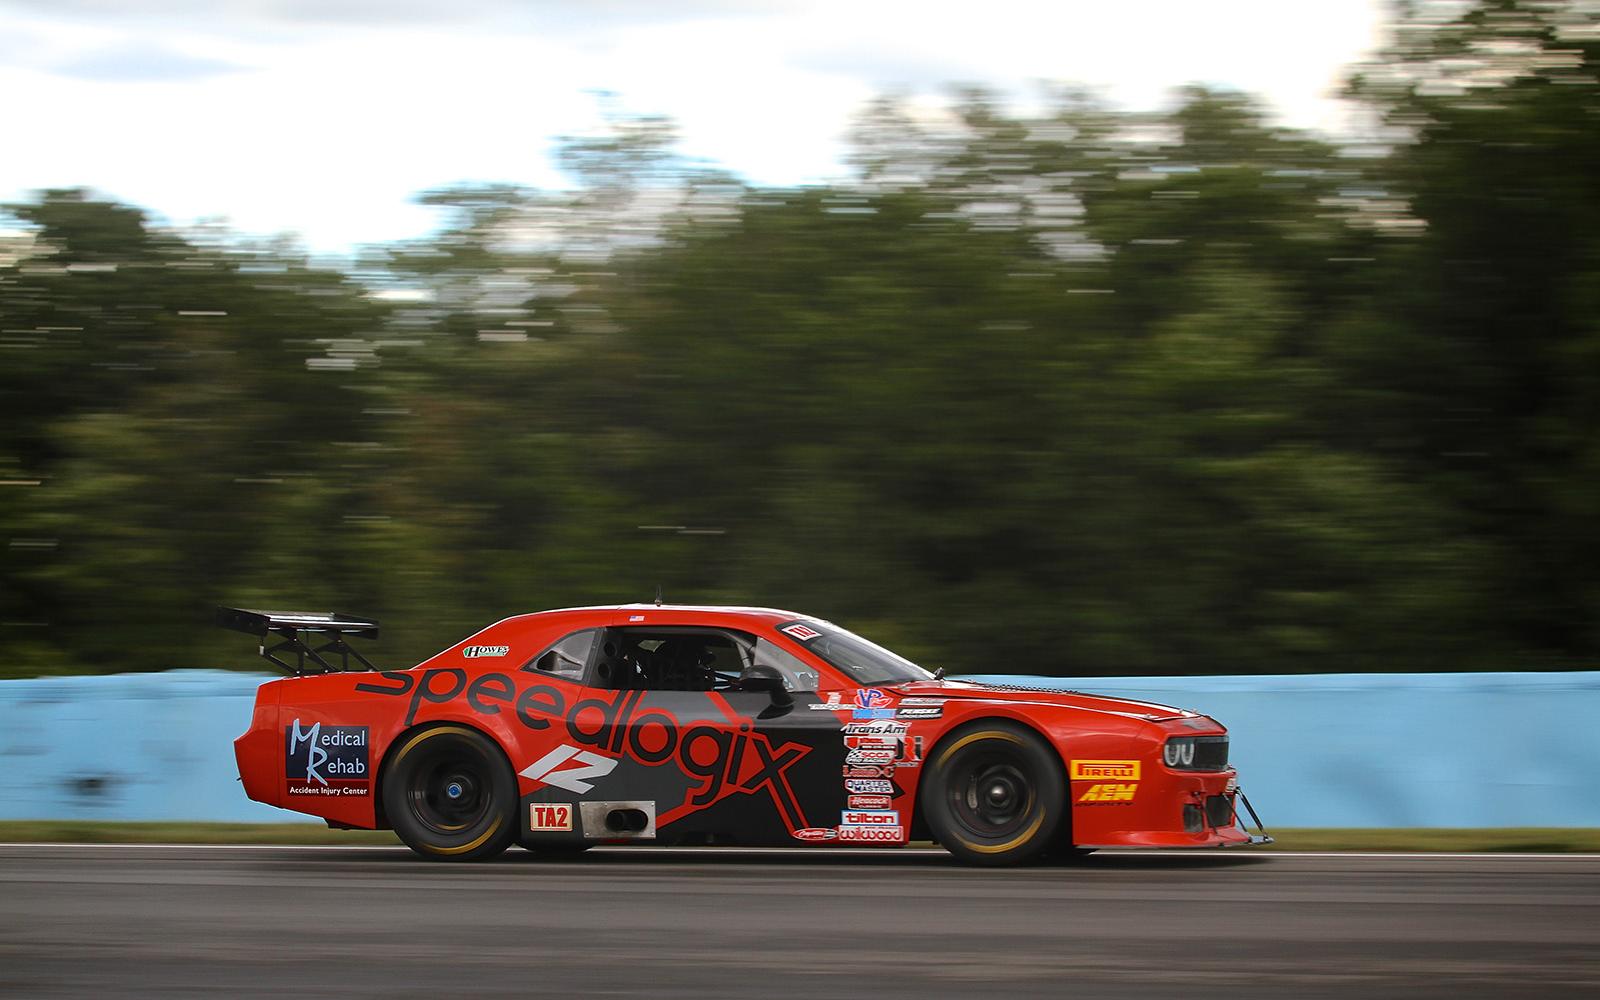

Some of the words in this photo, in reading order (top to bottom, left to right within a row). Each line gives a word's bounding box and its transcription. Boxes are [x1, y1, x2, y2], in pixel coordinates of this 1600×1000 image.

[858, 689, 883, 708] VP
[290, 718, 365, 755] Medical
[845, 724, 881, 734] Trans
[883, 725, 905, 734] Am
[355, 668, 812, 832] speedlogix
[307, 746, 365, 786] Rehab
[518, 744, 619, 794] 12
[1077, 763, 1134, 776] PIRELLI
[290, 786, 319, 794] Accident
[321, 787, 341, 796] Injury
[343, 787, 367, 795] Center
[847, 780, 890, 788] QUARTER
[1078, 784, 1138, 801] AEM
[535, 807, 568, 827] TA2
[845, 813, 895, 823] tilton
[840, 827, 901, 839] wilwood
